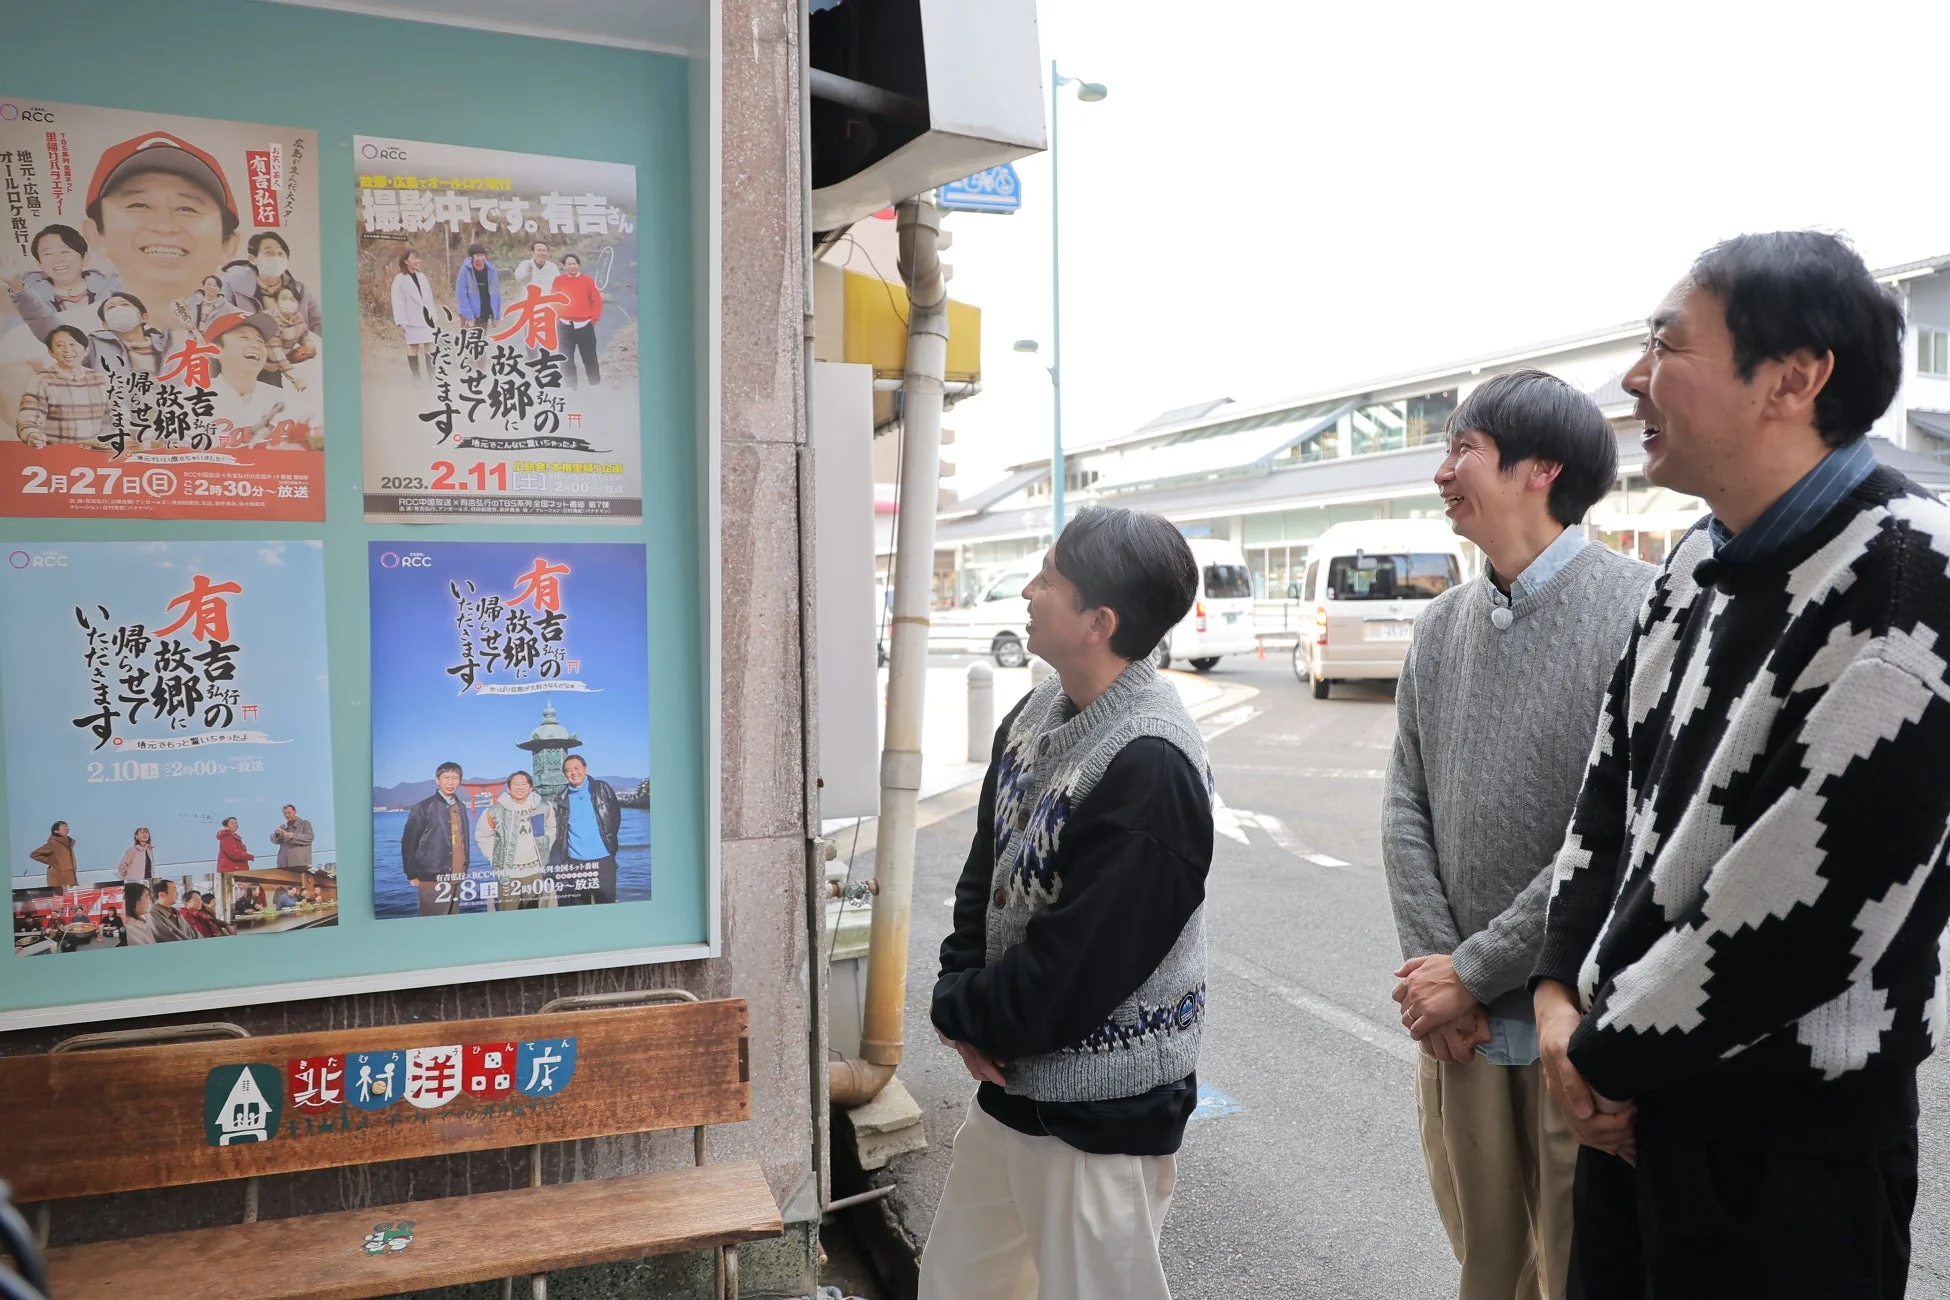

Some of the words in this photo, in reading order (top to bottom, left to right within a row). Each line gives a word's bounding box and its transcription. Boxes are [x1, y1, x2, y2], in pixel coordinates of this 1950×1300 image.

[22, 111, 55, 123] RCC
[380, 149, 408, 160] RCC
[17, 149, 42, 218] 地元・広島で
[45, 131, 64, 216] 里帰りバラエティー
[249, 155, 276, 223] 有吉弘行
[271, 147, 281, 188] お笑い芸人
[283, 137, 305, 227] 広島が生んだ大スター
[361, 188, 634, 235] 撮影中です。有吉さん
[155, 339, 221, 452] 有吉弘行の
[418, 304, 462, 446] いただきます。
[454, 327, 490, 423] 帰らせて
[487, 344, 534, 432] 故郷に
[490, 284, 571, 434] 有吉弘行の
[97, 353, 133, 461] いただきます。
[126, 371, 155, 443] 帰らせて
[154, 386, 192, 450] 故郷に
[471, 438, 578, 450] 地元でこんなに驚いちゃったよ
[21, 466, 141, 496] 2月27日
[33, 554, 68, 568] RCC
[401, 555, 432, 568] RCC
[151, 574, 243, 729] 有吉弘行の
[446, 579, 483, 693] いただきます。
[476, 596, 503, 674] 帰らせて
[502, 609, 541, 679] 故郷に
[505, 558, 571, 679] 有吉弘行の
[72, 604, 124, 753] いただきます。
[112, 623, 152, 725] 帰らせて
[150, 639, 204, 730] 故郷に
[136, 733, 249, 750] 地元でもっと驚いちゃったよ
[434, 879, 477, 903] 2.8
